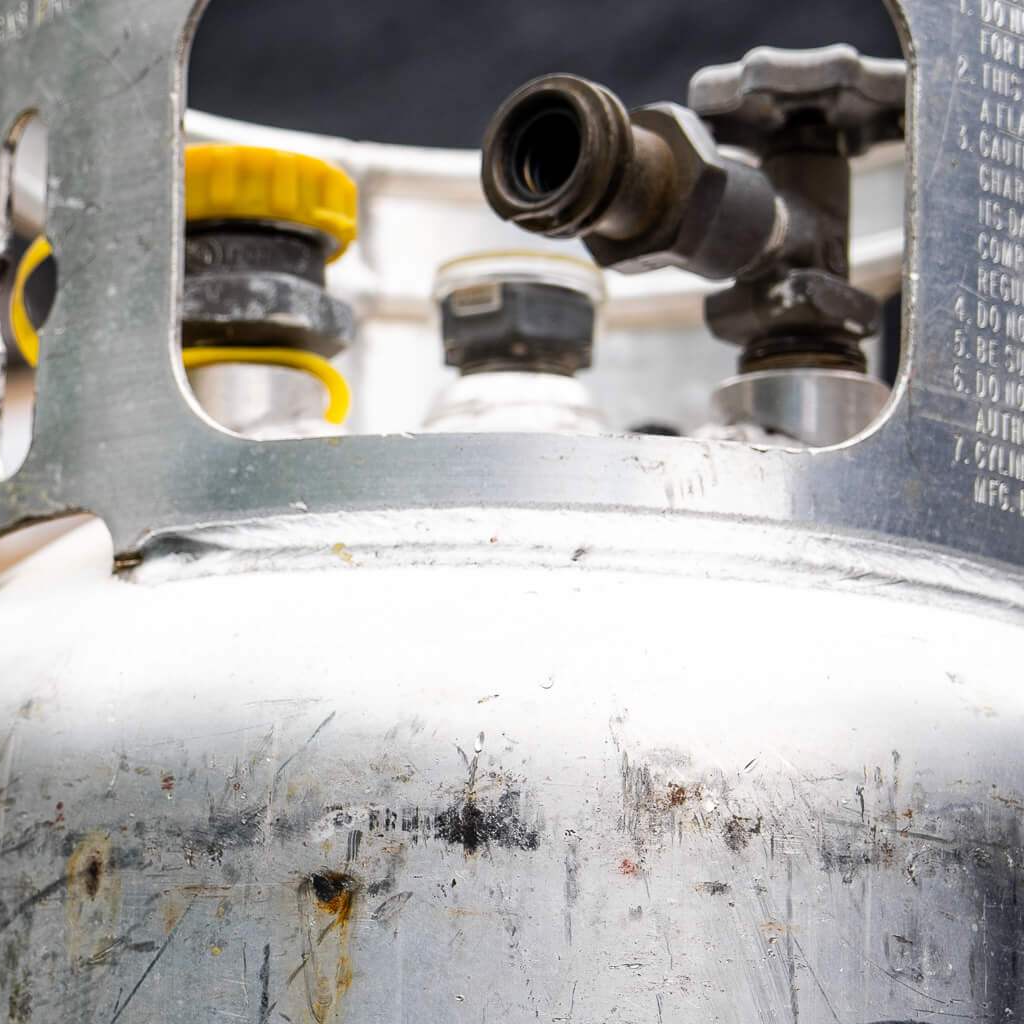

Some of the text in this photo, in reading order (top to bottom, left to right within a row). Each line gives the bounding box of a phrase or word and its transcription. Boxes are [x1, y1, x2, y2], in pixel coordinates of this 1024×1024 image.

[981, 0, 1006, 28] DO
[980, 29, 1015, 65] FOR
[957, 54, 976, 85] 2.
[982, 61, 1021, 101] THIS
[979, 97, 990, 125] A
[959, 124, 975, 153] 3.
[979, 163, 1024, 205] CHAR
[979, 198, 1003, 231] ITS
[978, 231, 1024, 272] COMP
[955, 295, 972, 325] 4.
[977, 300, 1001, 333] DO
[954, 328, 972, 359] 5.
[977, 335, 999, 368] BE
[954, 364, 971, 394] 6.
[976, 369, 1000, 403] DO
[953, 432, 970, 465] 7.
